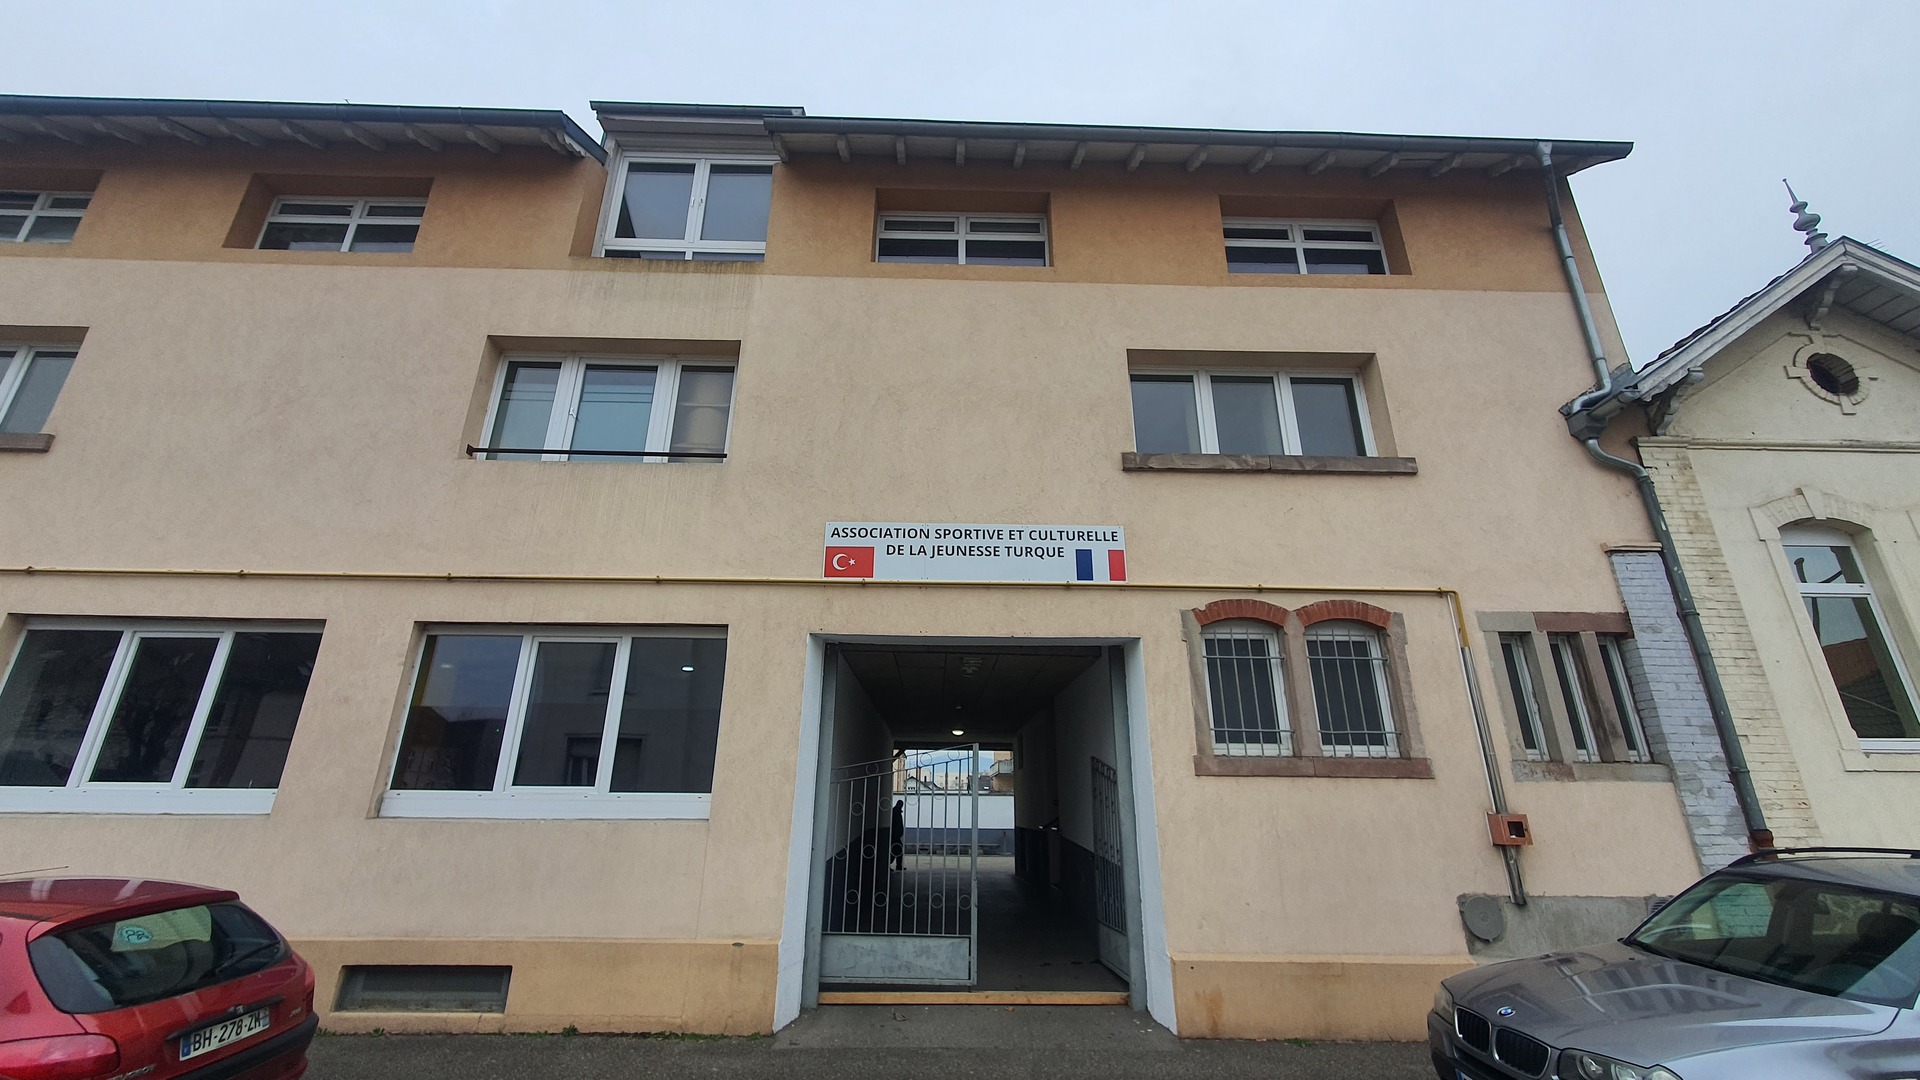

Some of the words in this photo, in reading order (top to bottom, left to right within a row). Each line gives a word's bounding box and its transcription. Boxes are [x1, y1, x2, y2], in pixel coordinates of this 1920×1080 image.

[831, 527, 930, 539] ASSOCIATION
[934, 528, 1004, 540] SPORTIVE
[1009, 529, 1025, 541] ET
[1029, 530, 1119, 542] CULTURELLE
[886, 544, 905, 556] DE
[909, 545, 928, 556] LA
[930, 545, 1001, 559] JEUNESSE
[1005, 546, 1065, 560] TURQUE
